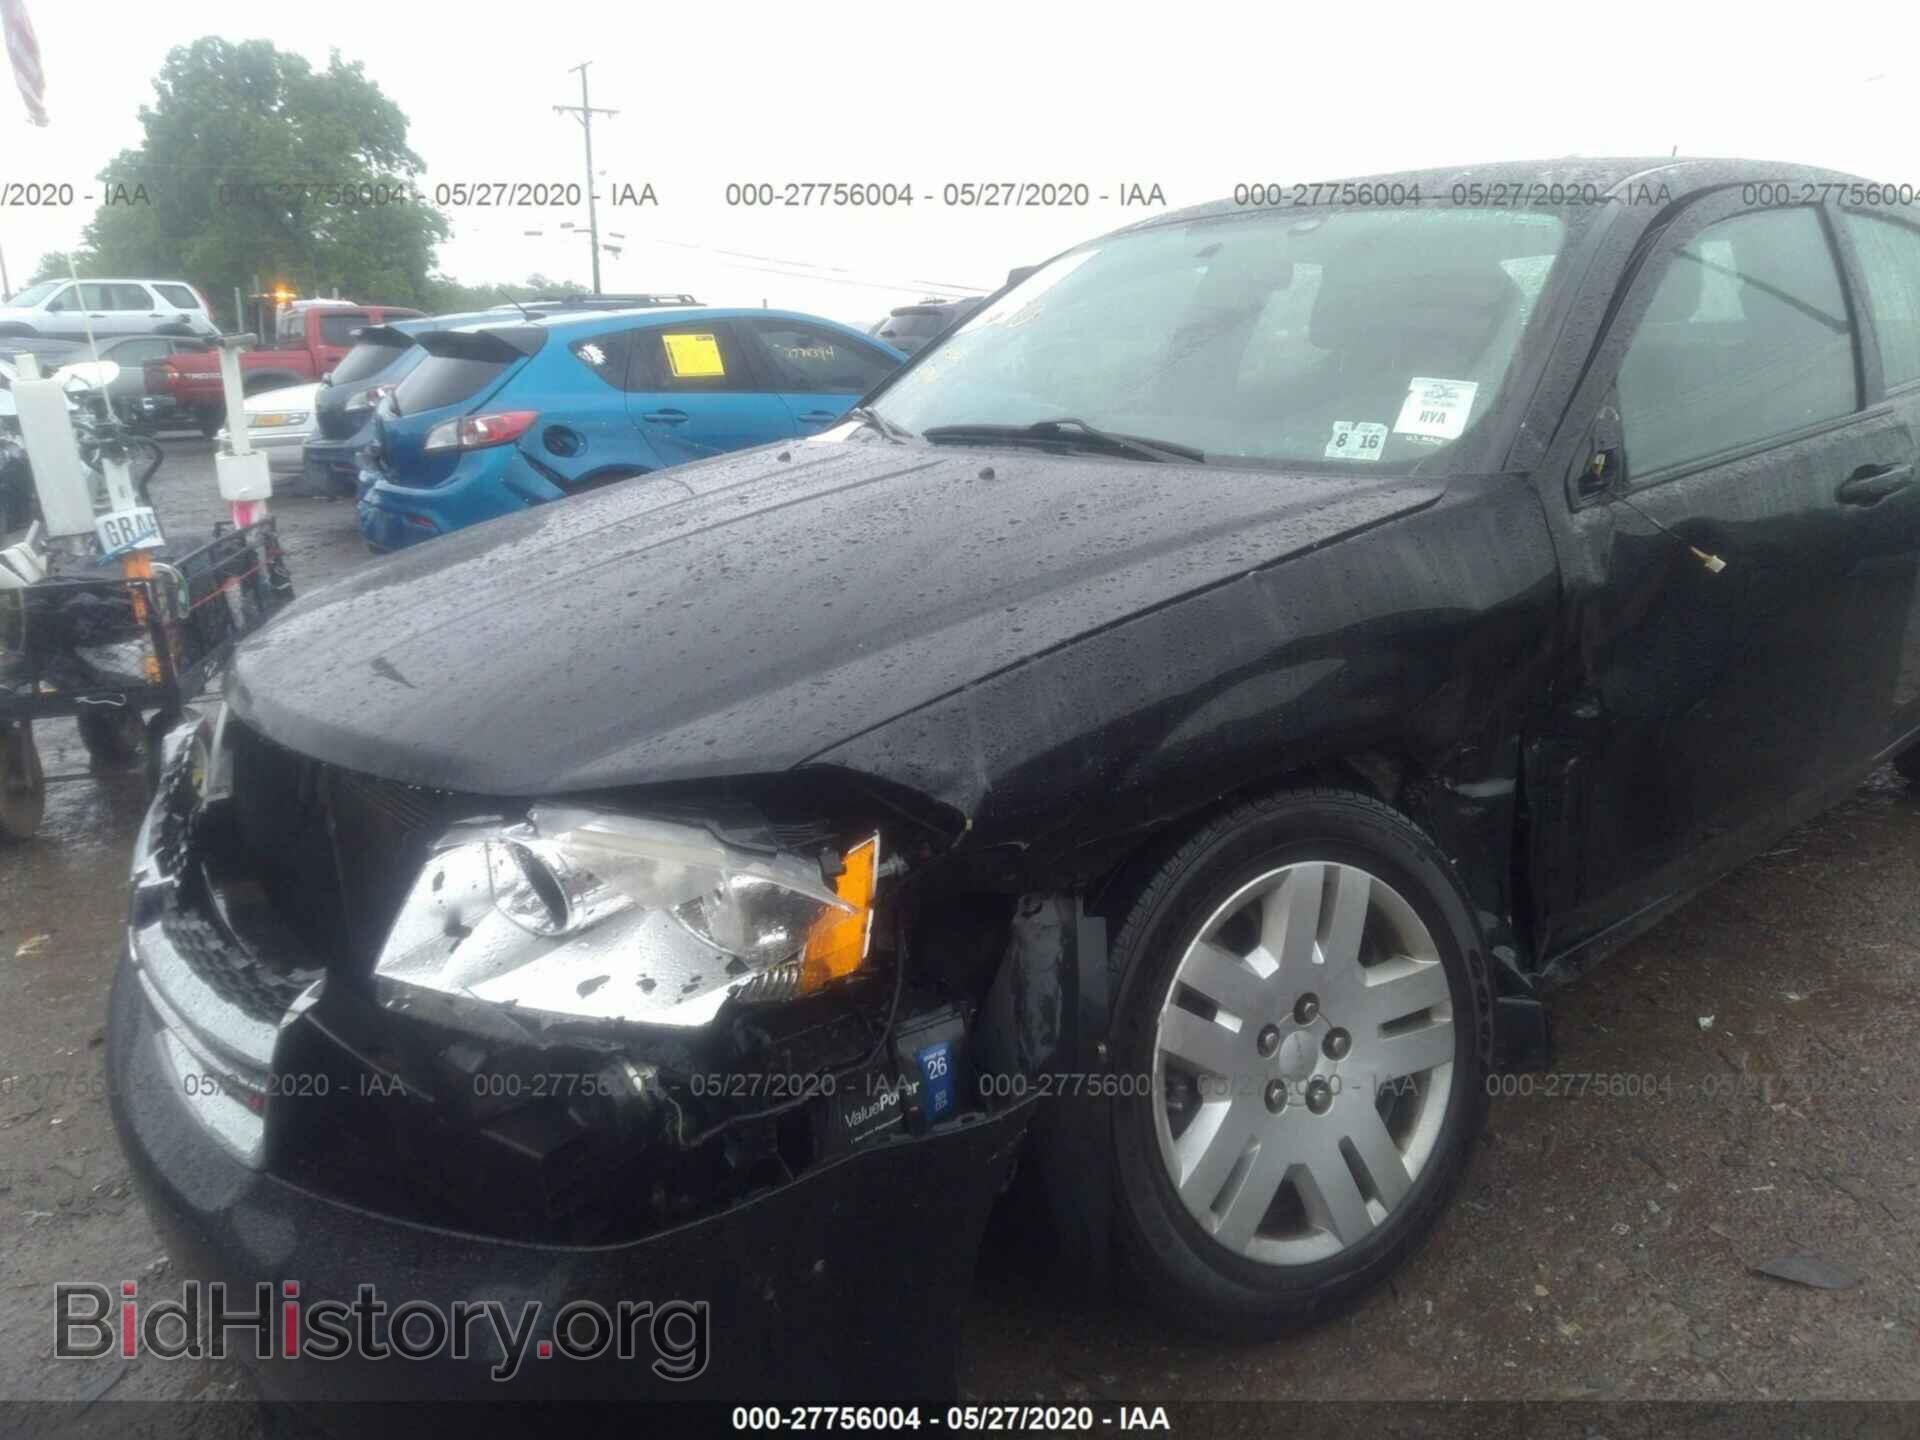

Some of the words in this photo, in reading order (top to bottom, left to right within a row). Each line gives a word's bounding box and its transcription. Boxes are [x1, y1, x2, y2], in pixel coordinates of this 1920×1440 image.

[1336, 432, 1348, 448] 8
[1359, 434, 1380, 449] 16
[927, 1056, 948, 1080] 26
